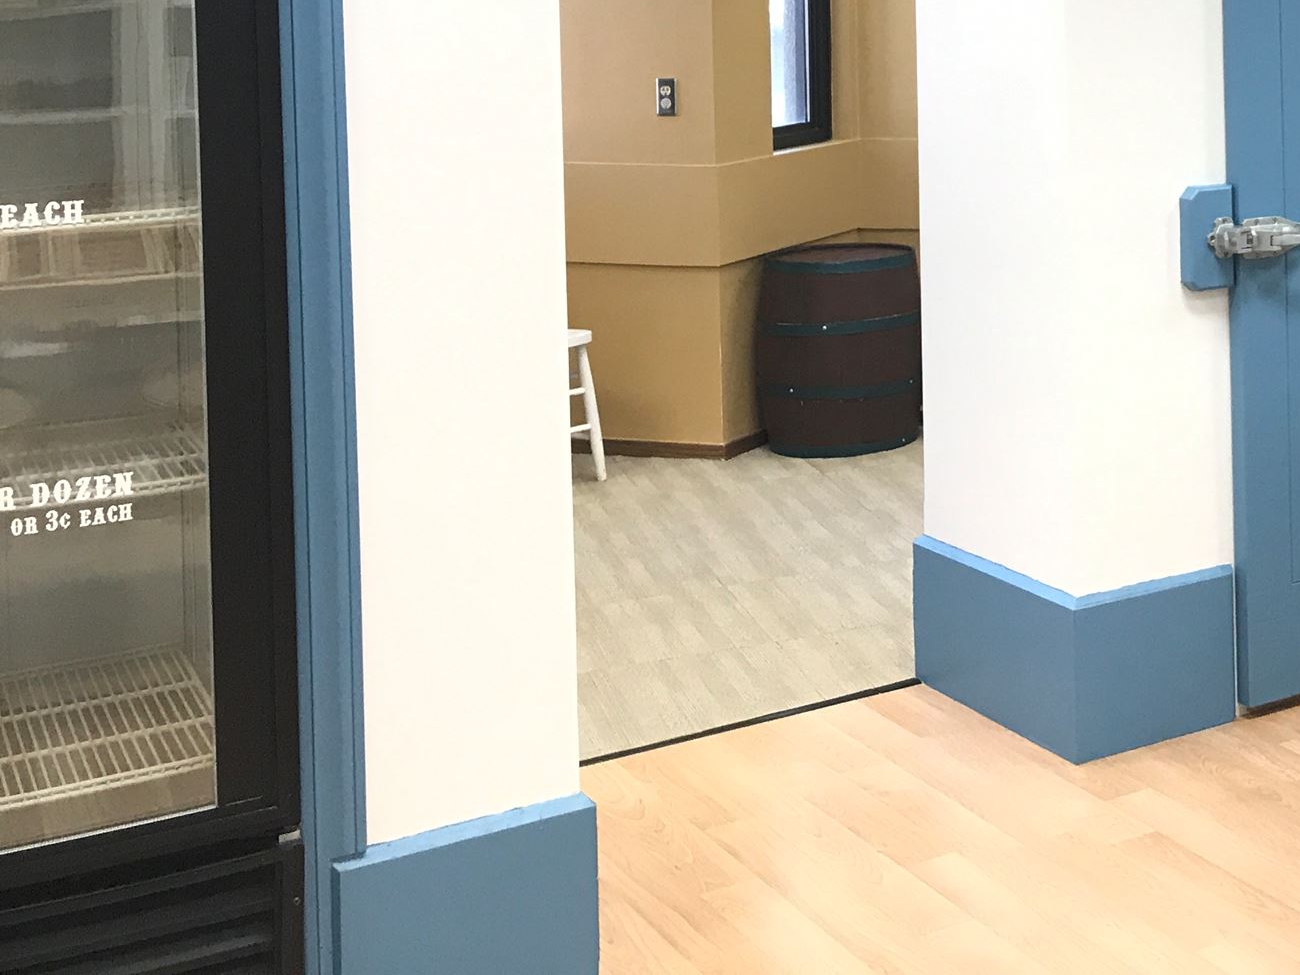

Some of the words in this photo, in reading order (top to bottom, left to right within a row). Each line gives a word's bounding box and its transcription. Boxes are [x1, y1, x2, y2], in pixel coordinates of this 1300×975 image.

[0, 200, 84, 230] EACH
[29, 472, 134, 507] DOZEN
[10, 516, 39, 536] OR
[45, 510, 71, 529] 3¢
[79, 503, 133, 527] EACH
